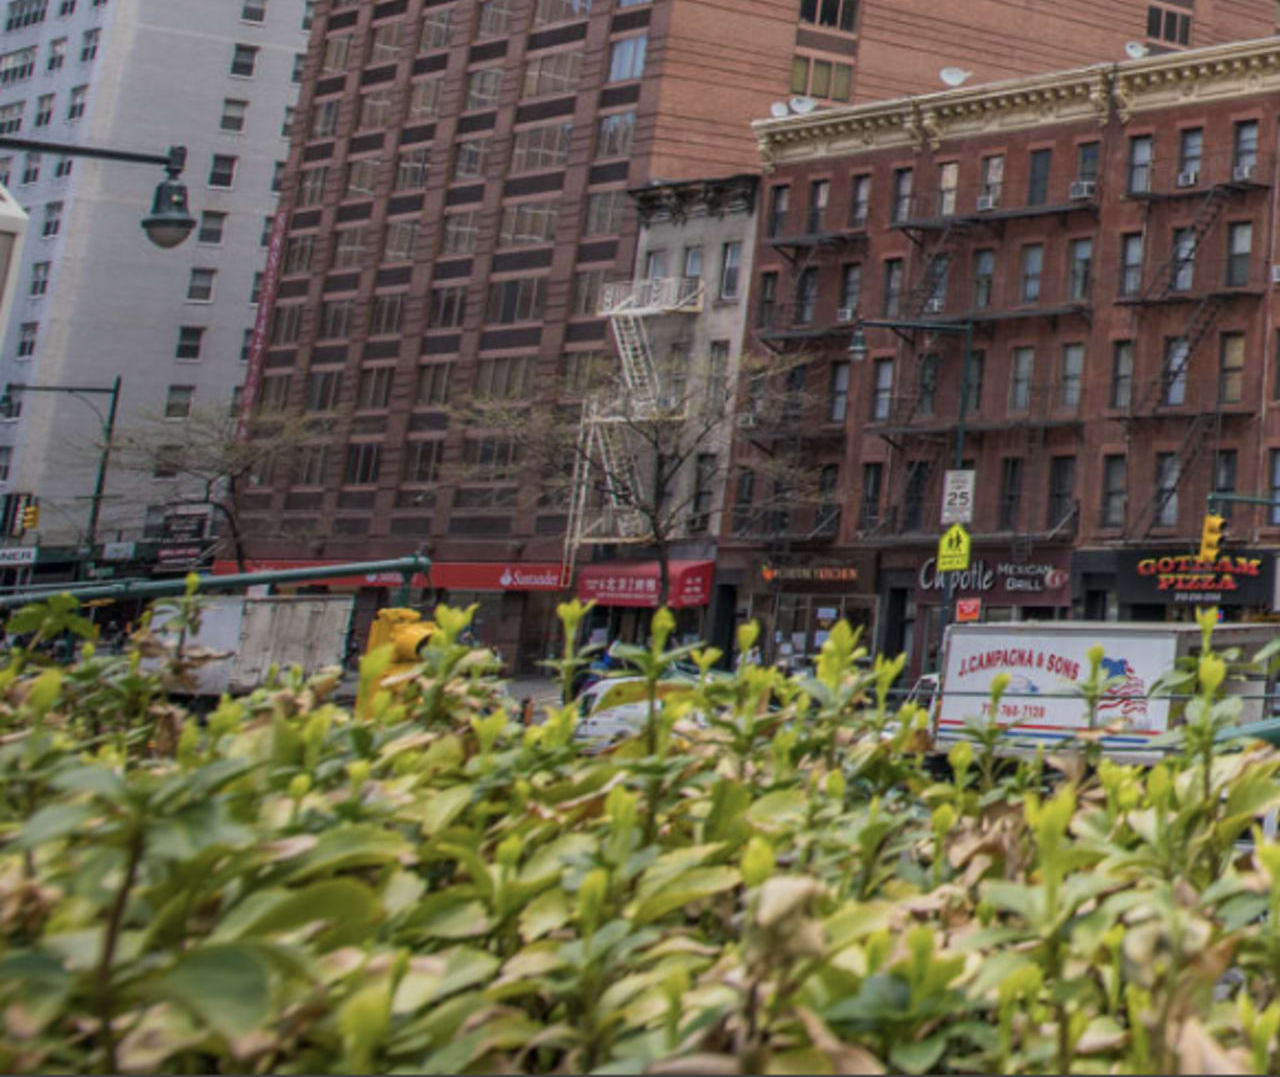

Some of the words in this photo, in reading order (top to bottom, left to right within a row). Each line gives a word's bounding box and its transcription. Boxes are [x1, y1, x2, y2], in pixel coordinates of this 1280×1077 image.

[946, 490, 970, 506] 25
[998, 563, 1053, 575] MEXICAN
[1137, 555, 1262, 575] GOTHAM
[512, 570, 559, 586] Santander
[1005, 577, 1042, 591] GRILL
[1157, 574, 1238, 590] PIZZA
[1046, 653, 1081, 681] SONS
